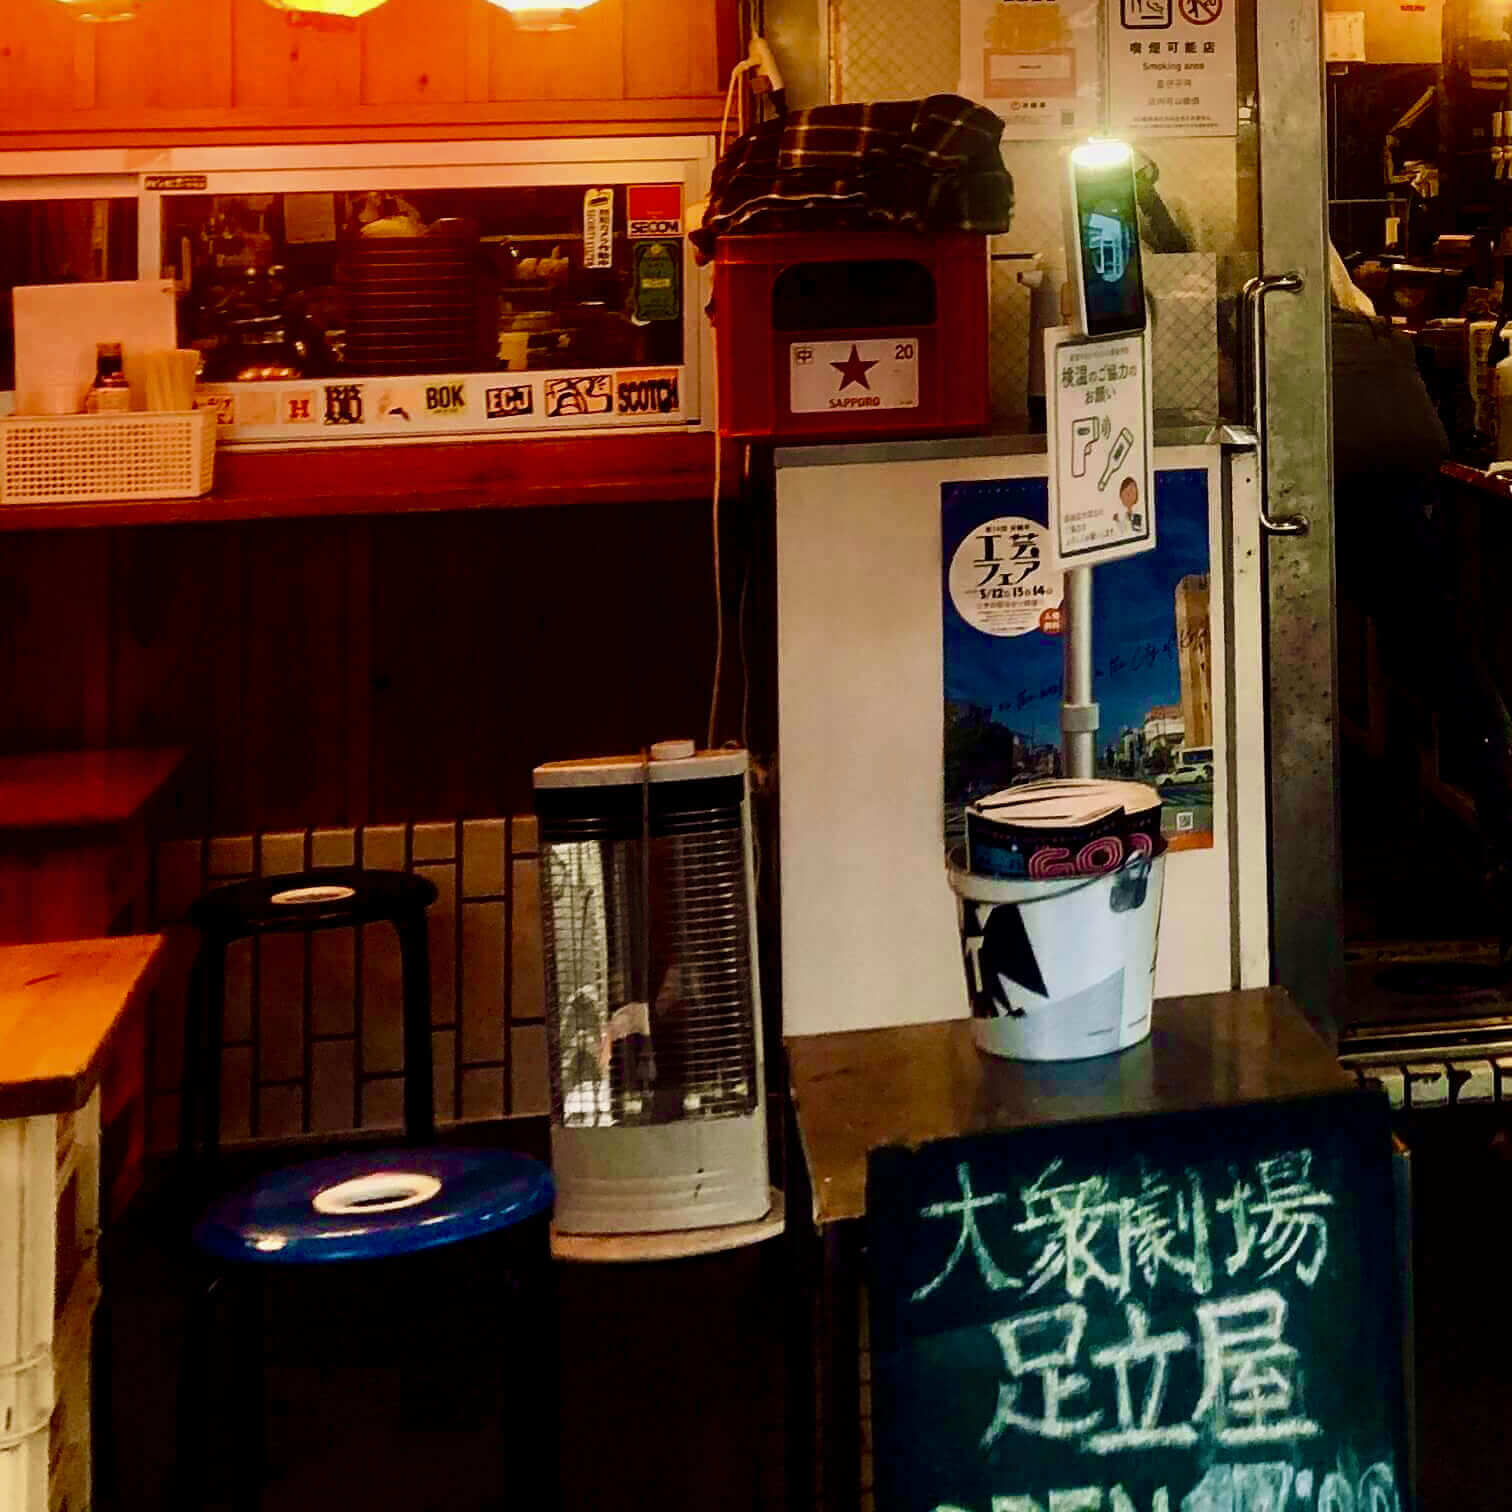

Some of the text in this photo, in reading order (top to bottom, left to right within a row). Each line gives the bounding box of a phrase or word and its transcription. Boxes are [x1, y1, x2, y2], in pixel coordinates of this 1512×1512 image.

[1129, 41, 1217, 54] 喫煙可能店
[631, 220, 679, 234] SECOM
[895, 344, 914, 360] 20
[828, 395, 881, 409] SAPPORO
[973, 560, 1041, 587] フェア
[911, 1148, 1334, 1302] 大衆劇場
[983, 1287, 1323, 1453] 足立屋
